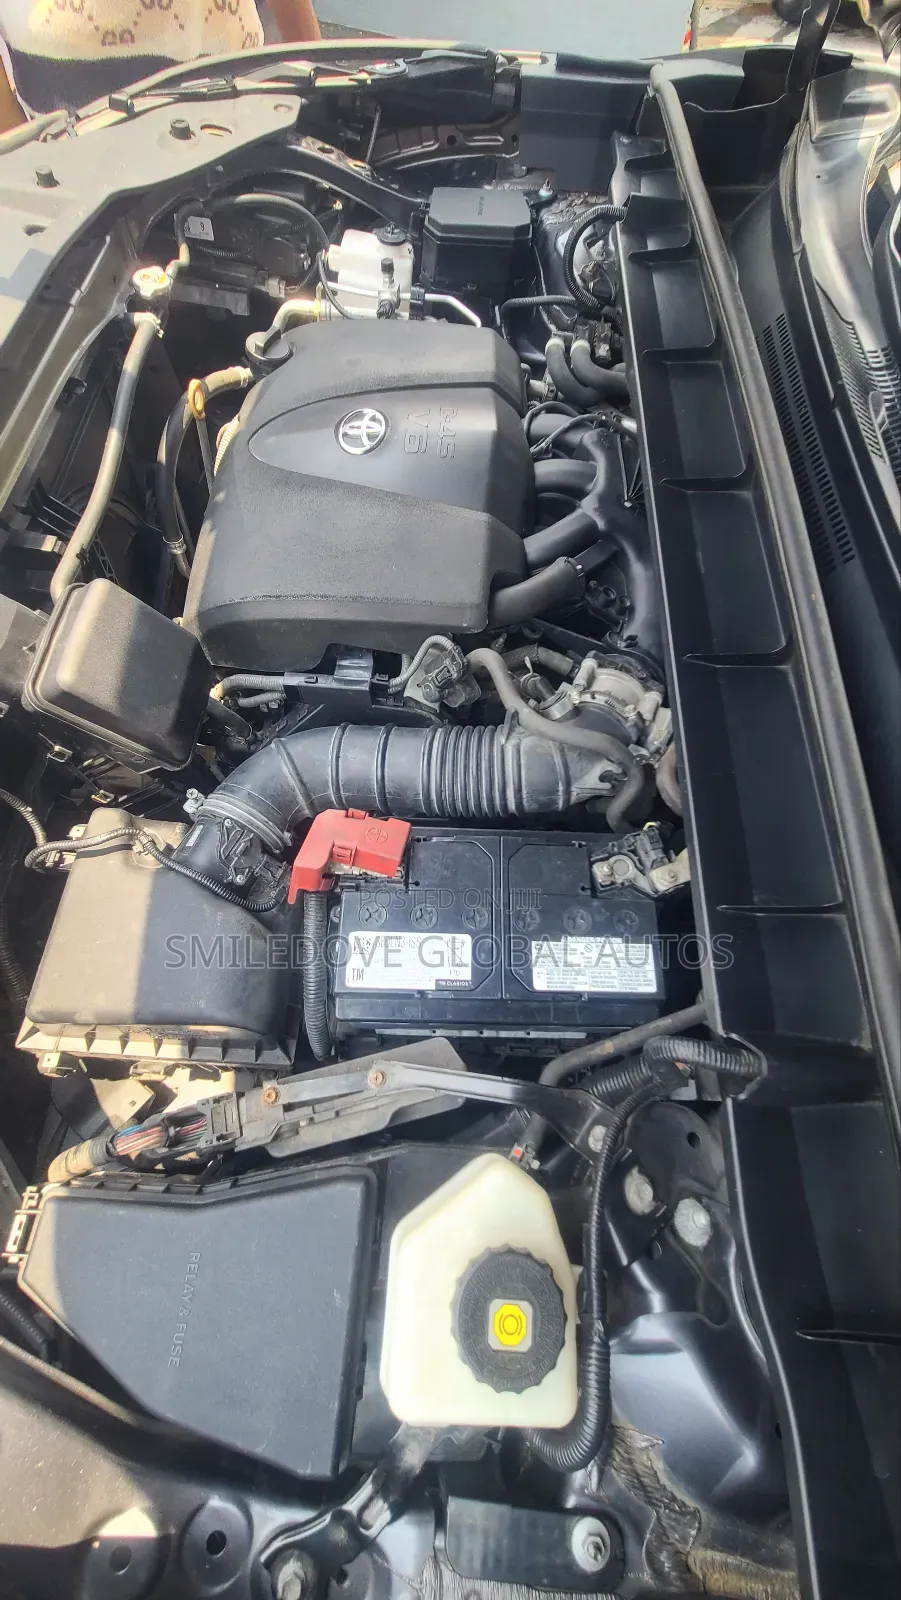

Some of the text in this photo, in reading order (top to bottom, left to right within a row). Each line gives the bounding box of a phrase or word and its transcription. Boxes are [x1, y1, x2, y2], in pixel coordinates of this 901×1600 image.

[404, 407, 432, 455] V6
[168, 1252, 201, 1368] RELAY & FUSE
